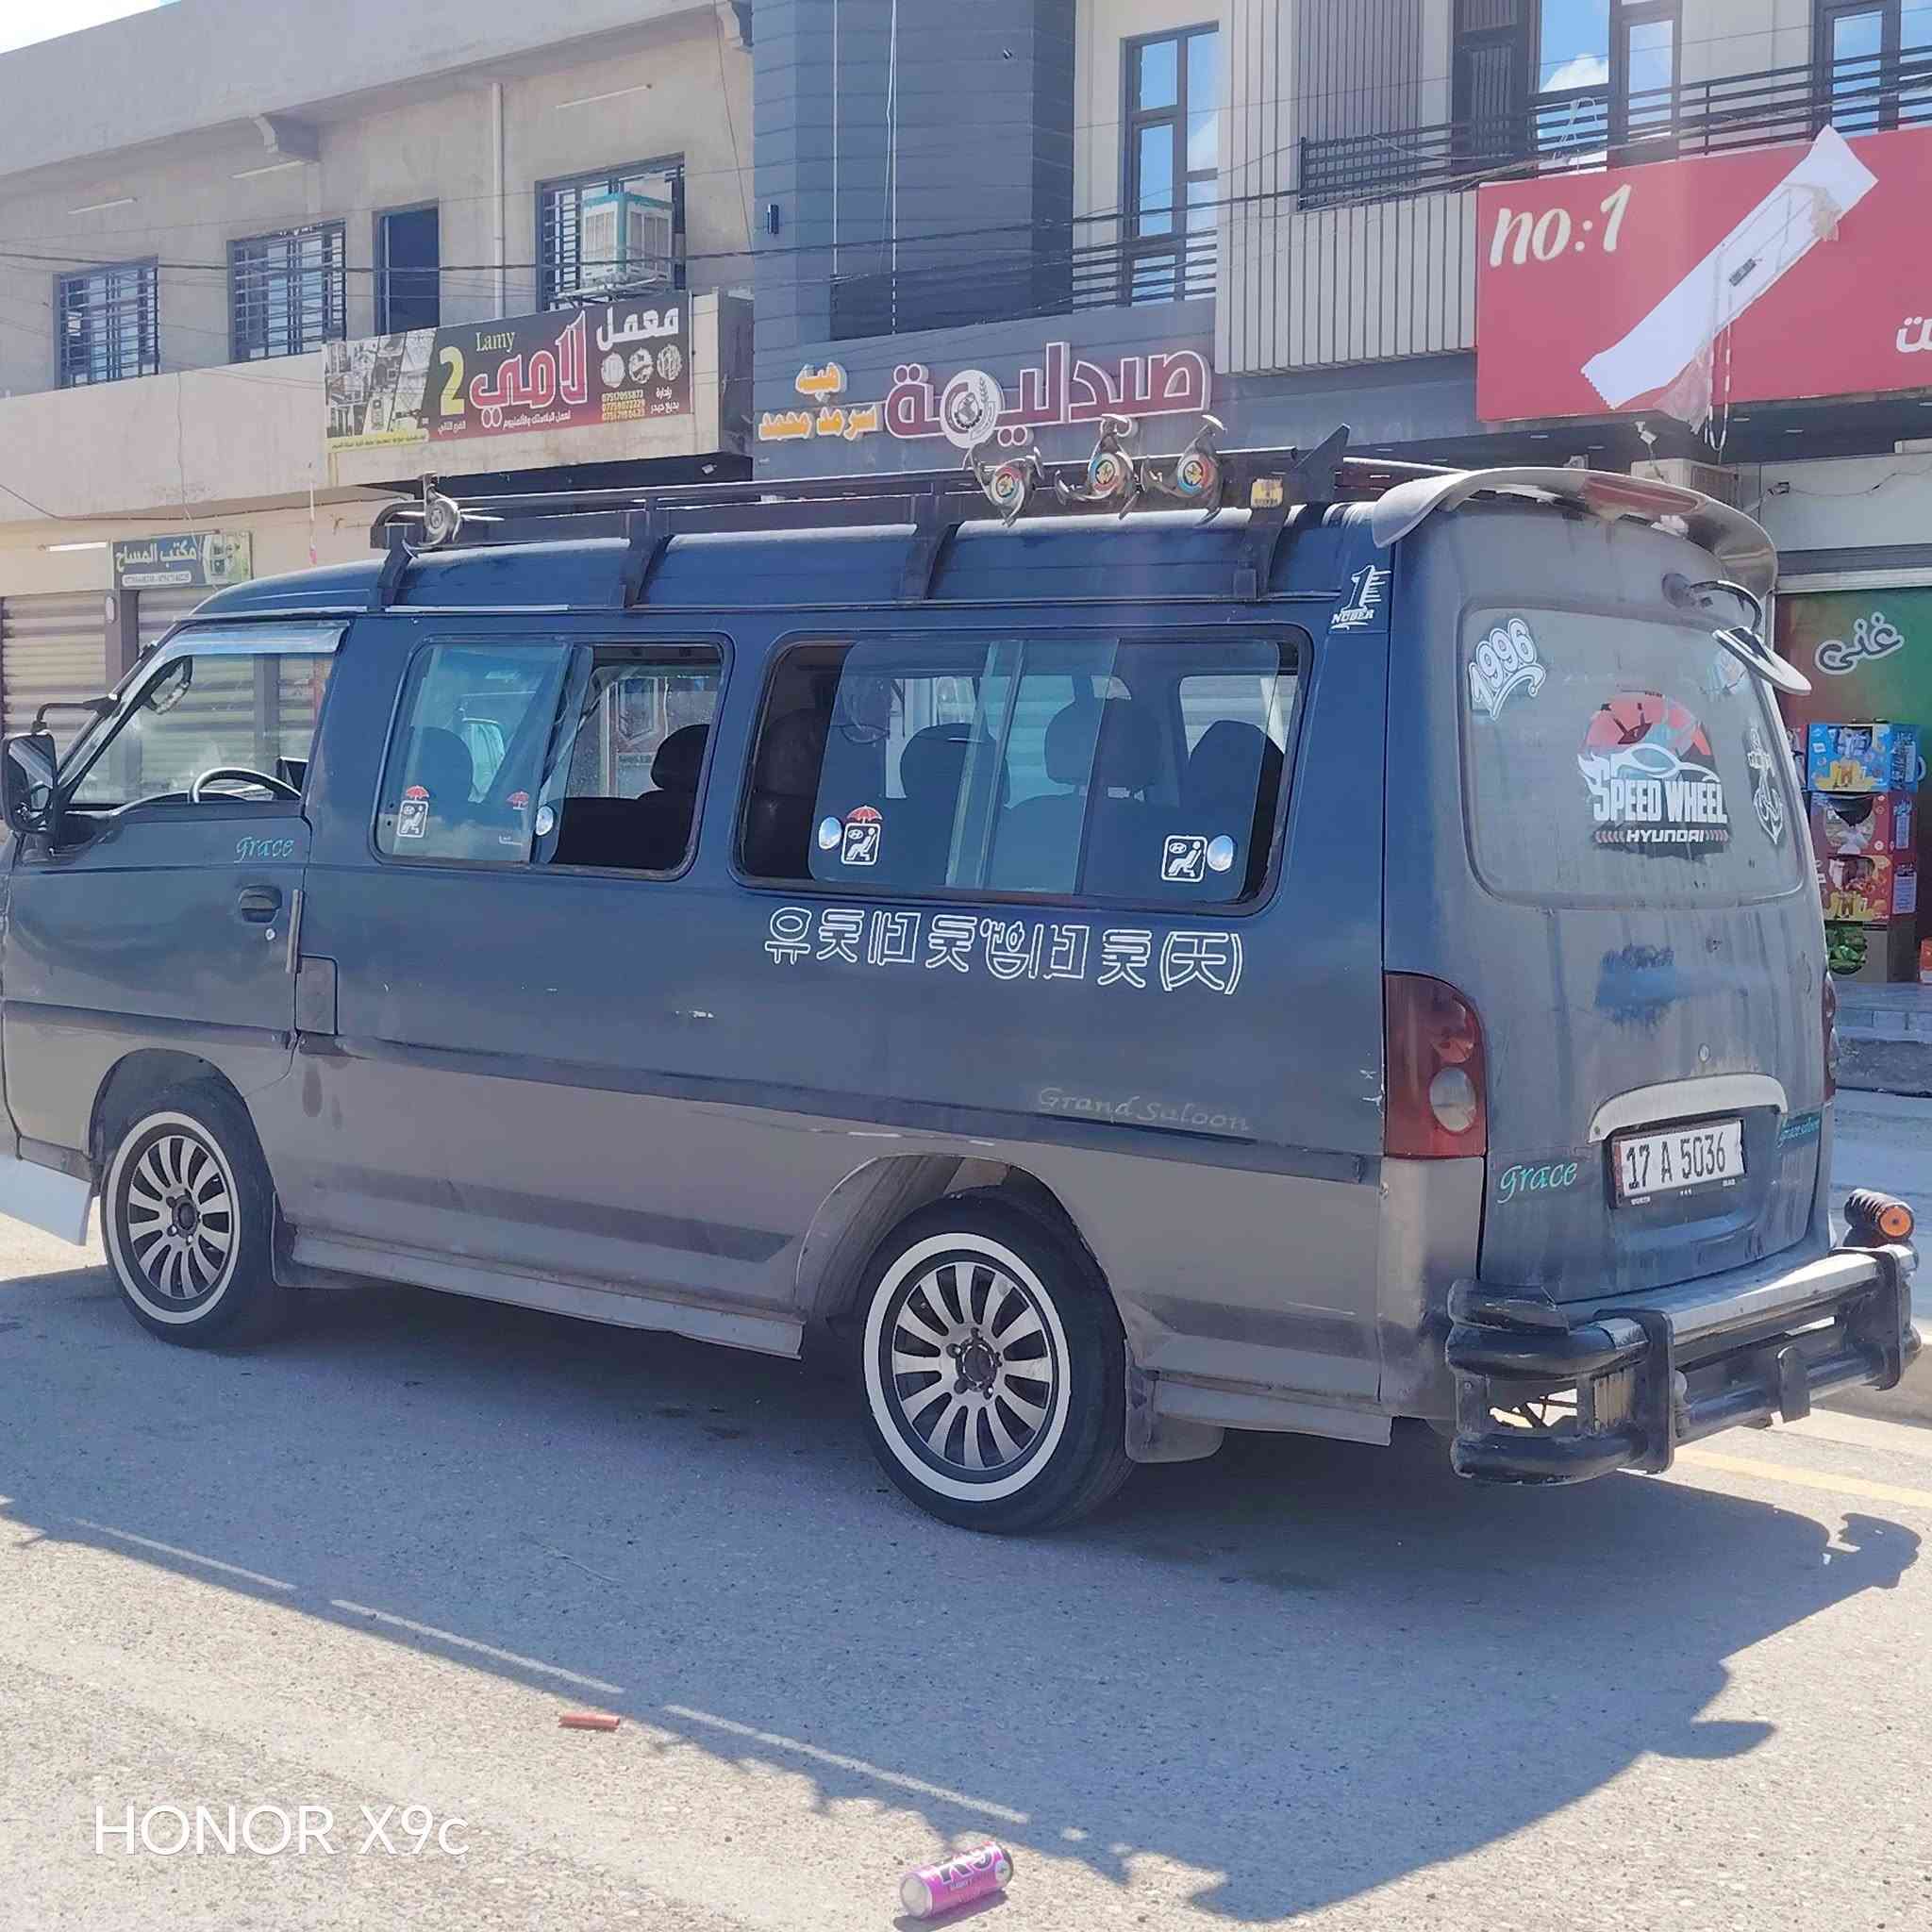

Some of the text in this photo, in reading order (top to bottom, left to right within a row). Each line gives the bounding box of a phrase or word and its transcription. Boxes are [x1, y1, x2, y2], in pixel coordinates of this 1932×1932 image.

[475, 332, 515, 353] Lamy
[596, 307, 679, 351] معمل
[440, 346, 466, 415] 2
[160, 540, 197, 568] مكتب
[1469, 618, 1543, 717] 1996
[1579, 755, 1662, 822] SPEED
[1665, 780, 1728, 823] WHEEL
[1626, 829, 1705, 842] HYUNDAI
[1040, 1088, 1140, 1117] Grand
[1626, 1144, 1650, 1189] 17
[1661, 1141, 1673, 1183] A
[1680, 1132, 1725, 1179] 5036
